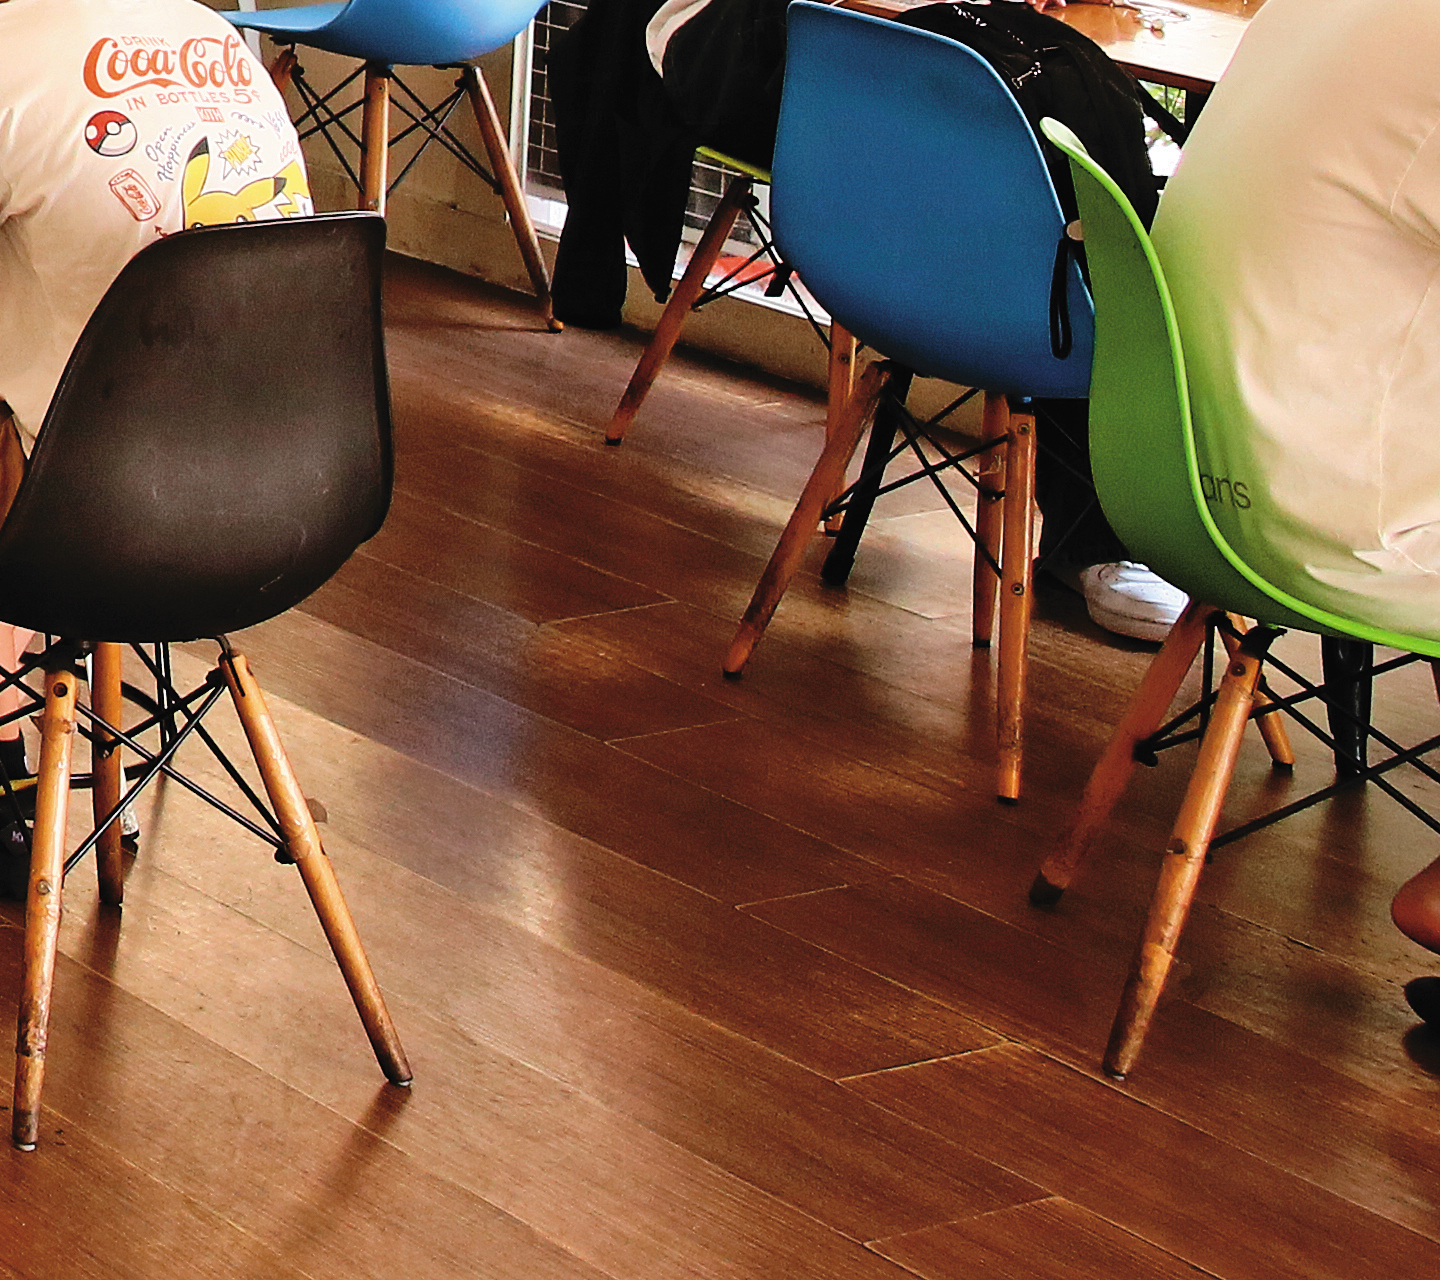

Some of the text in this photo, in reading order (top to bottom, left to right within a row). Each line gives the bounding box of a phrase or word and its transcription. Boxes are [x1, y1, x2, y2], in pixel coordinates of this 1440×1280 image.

[120, 35, 172, 47] DRINK
[83, 34, 253, 99] Coca-Cola
[126, 95, 148, 111] IN
[158, 91, 231, 106] BOTTLES
[145, 125, 173, 163] Open
[157, 120, 197, 183] Happiness
[1200, 473, 1251, 510] ans
